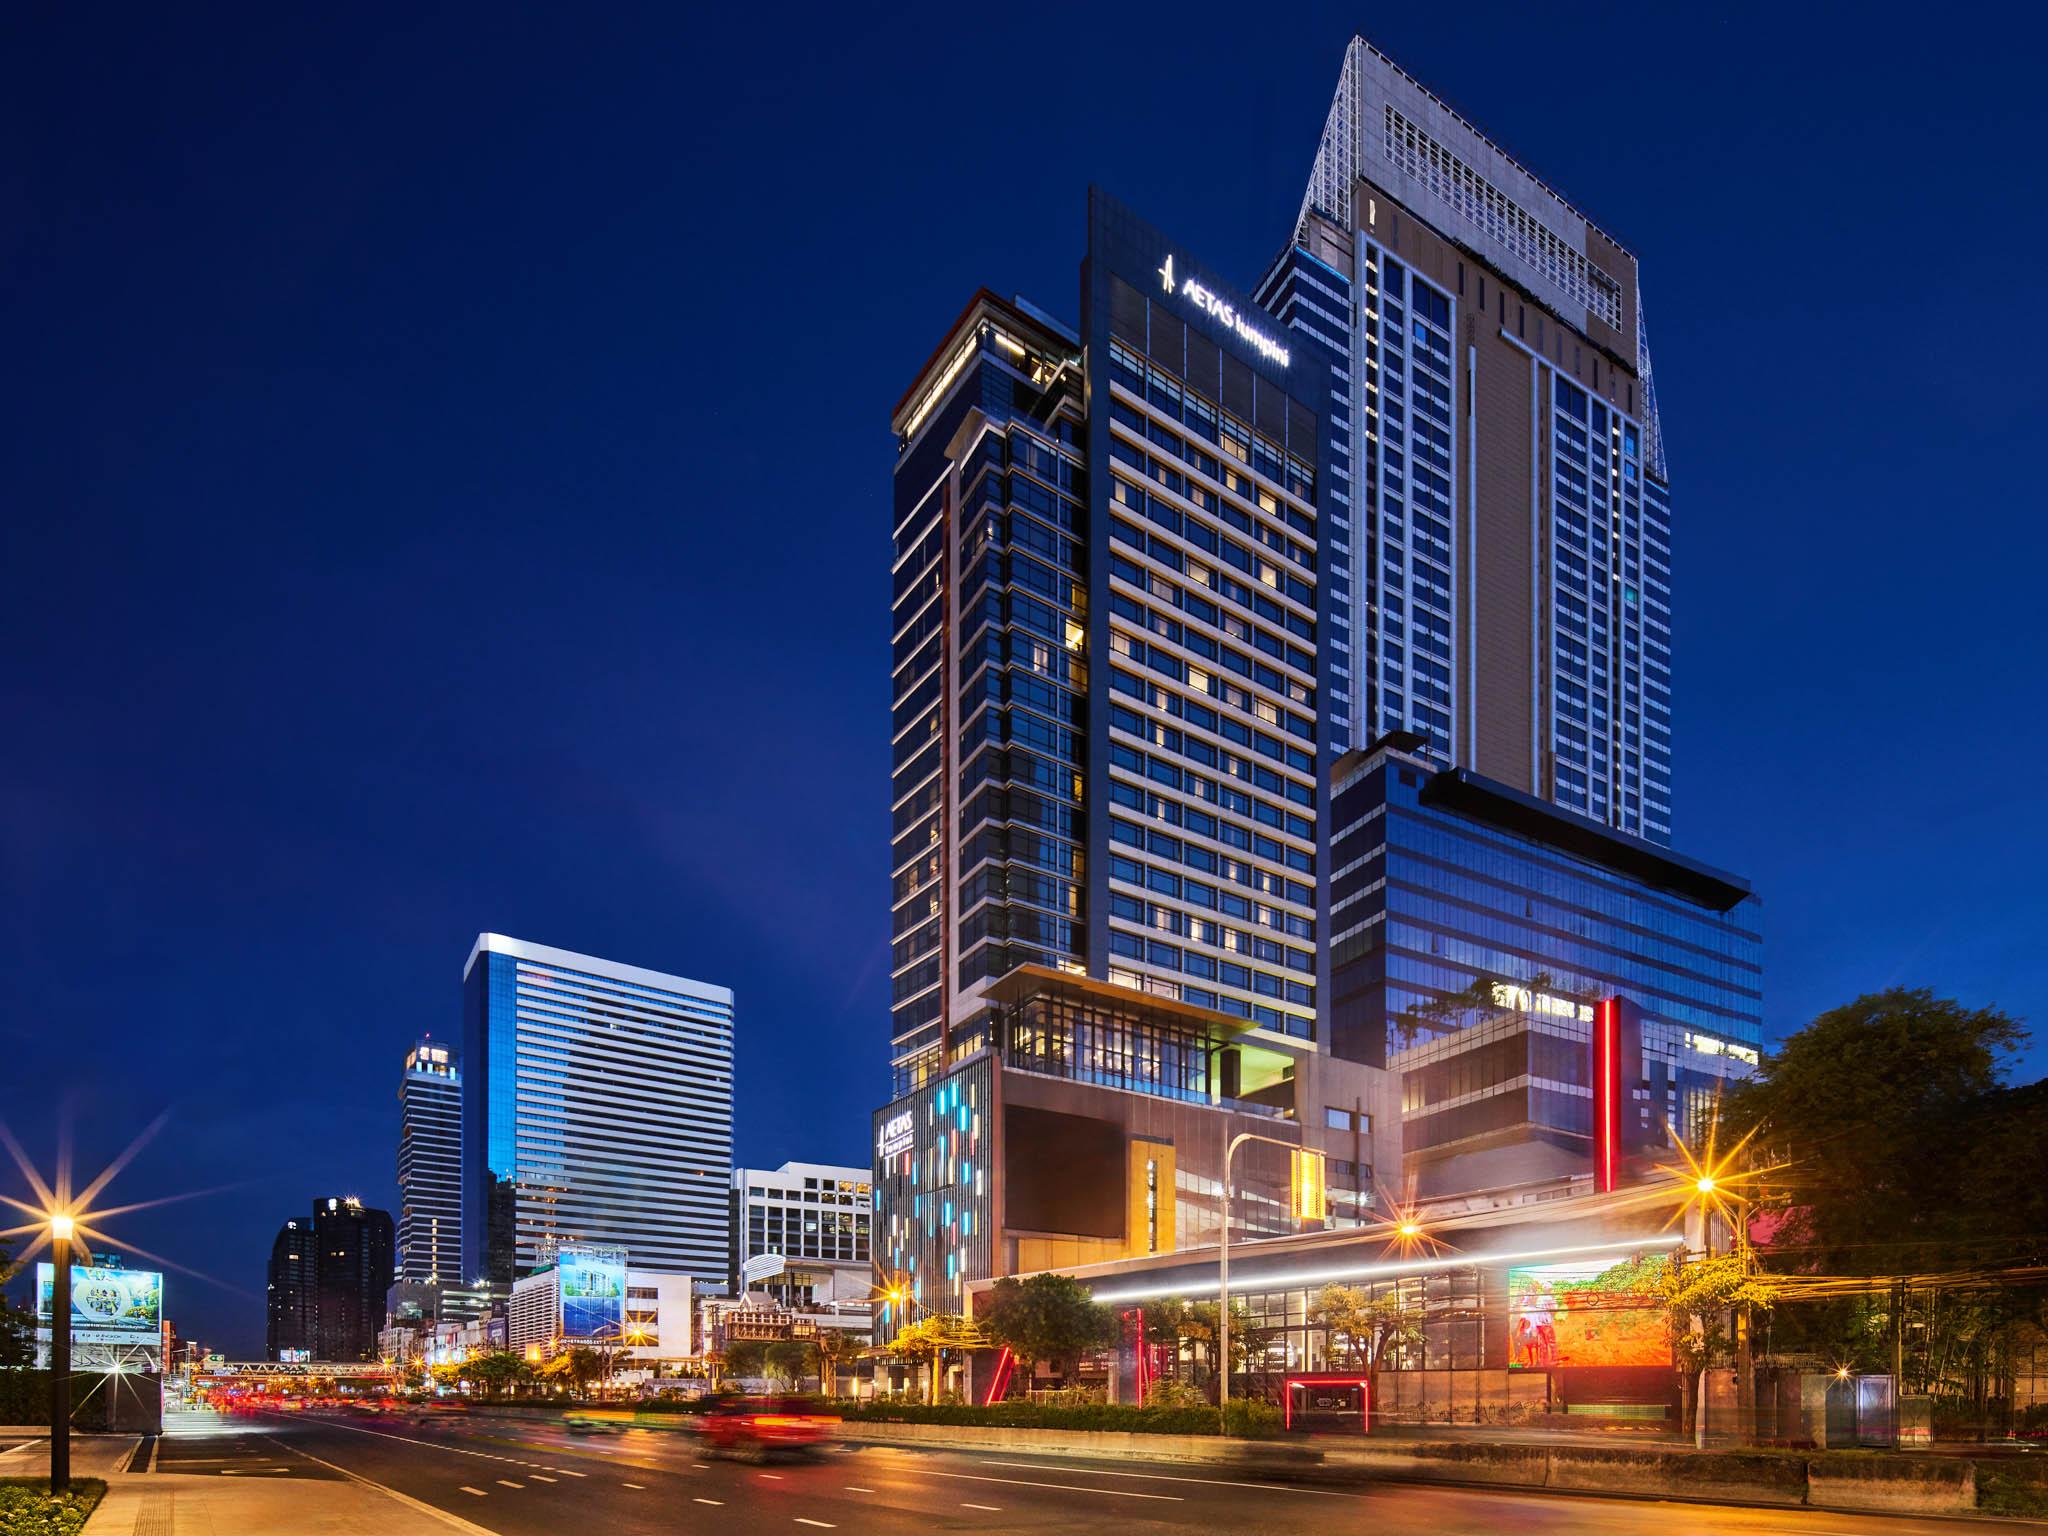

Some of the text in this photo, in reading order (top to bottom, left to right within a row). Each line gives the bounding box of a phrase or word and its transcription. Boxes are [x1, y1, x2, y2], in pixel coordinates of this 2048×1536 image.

[1182, 279, 1289, 367] AETAS lumpini
[885, 1110, 913, 1139] AETAS
